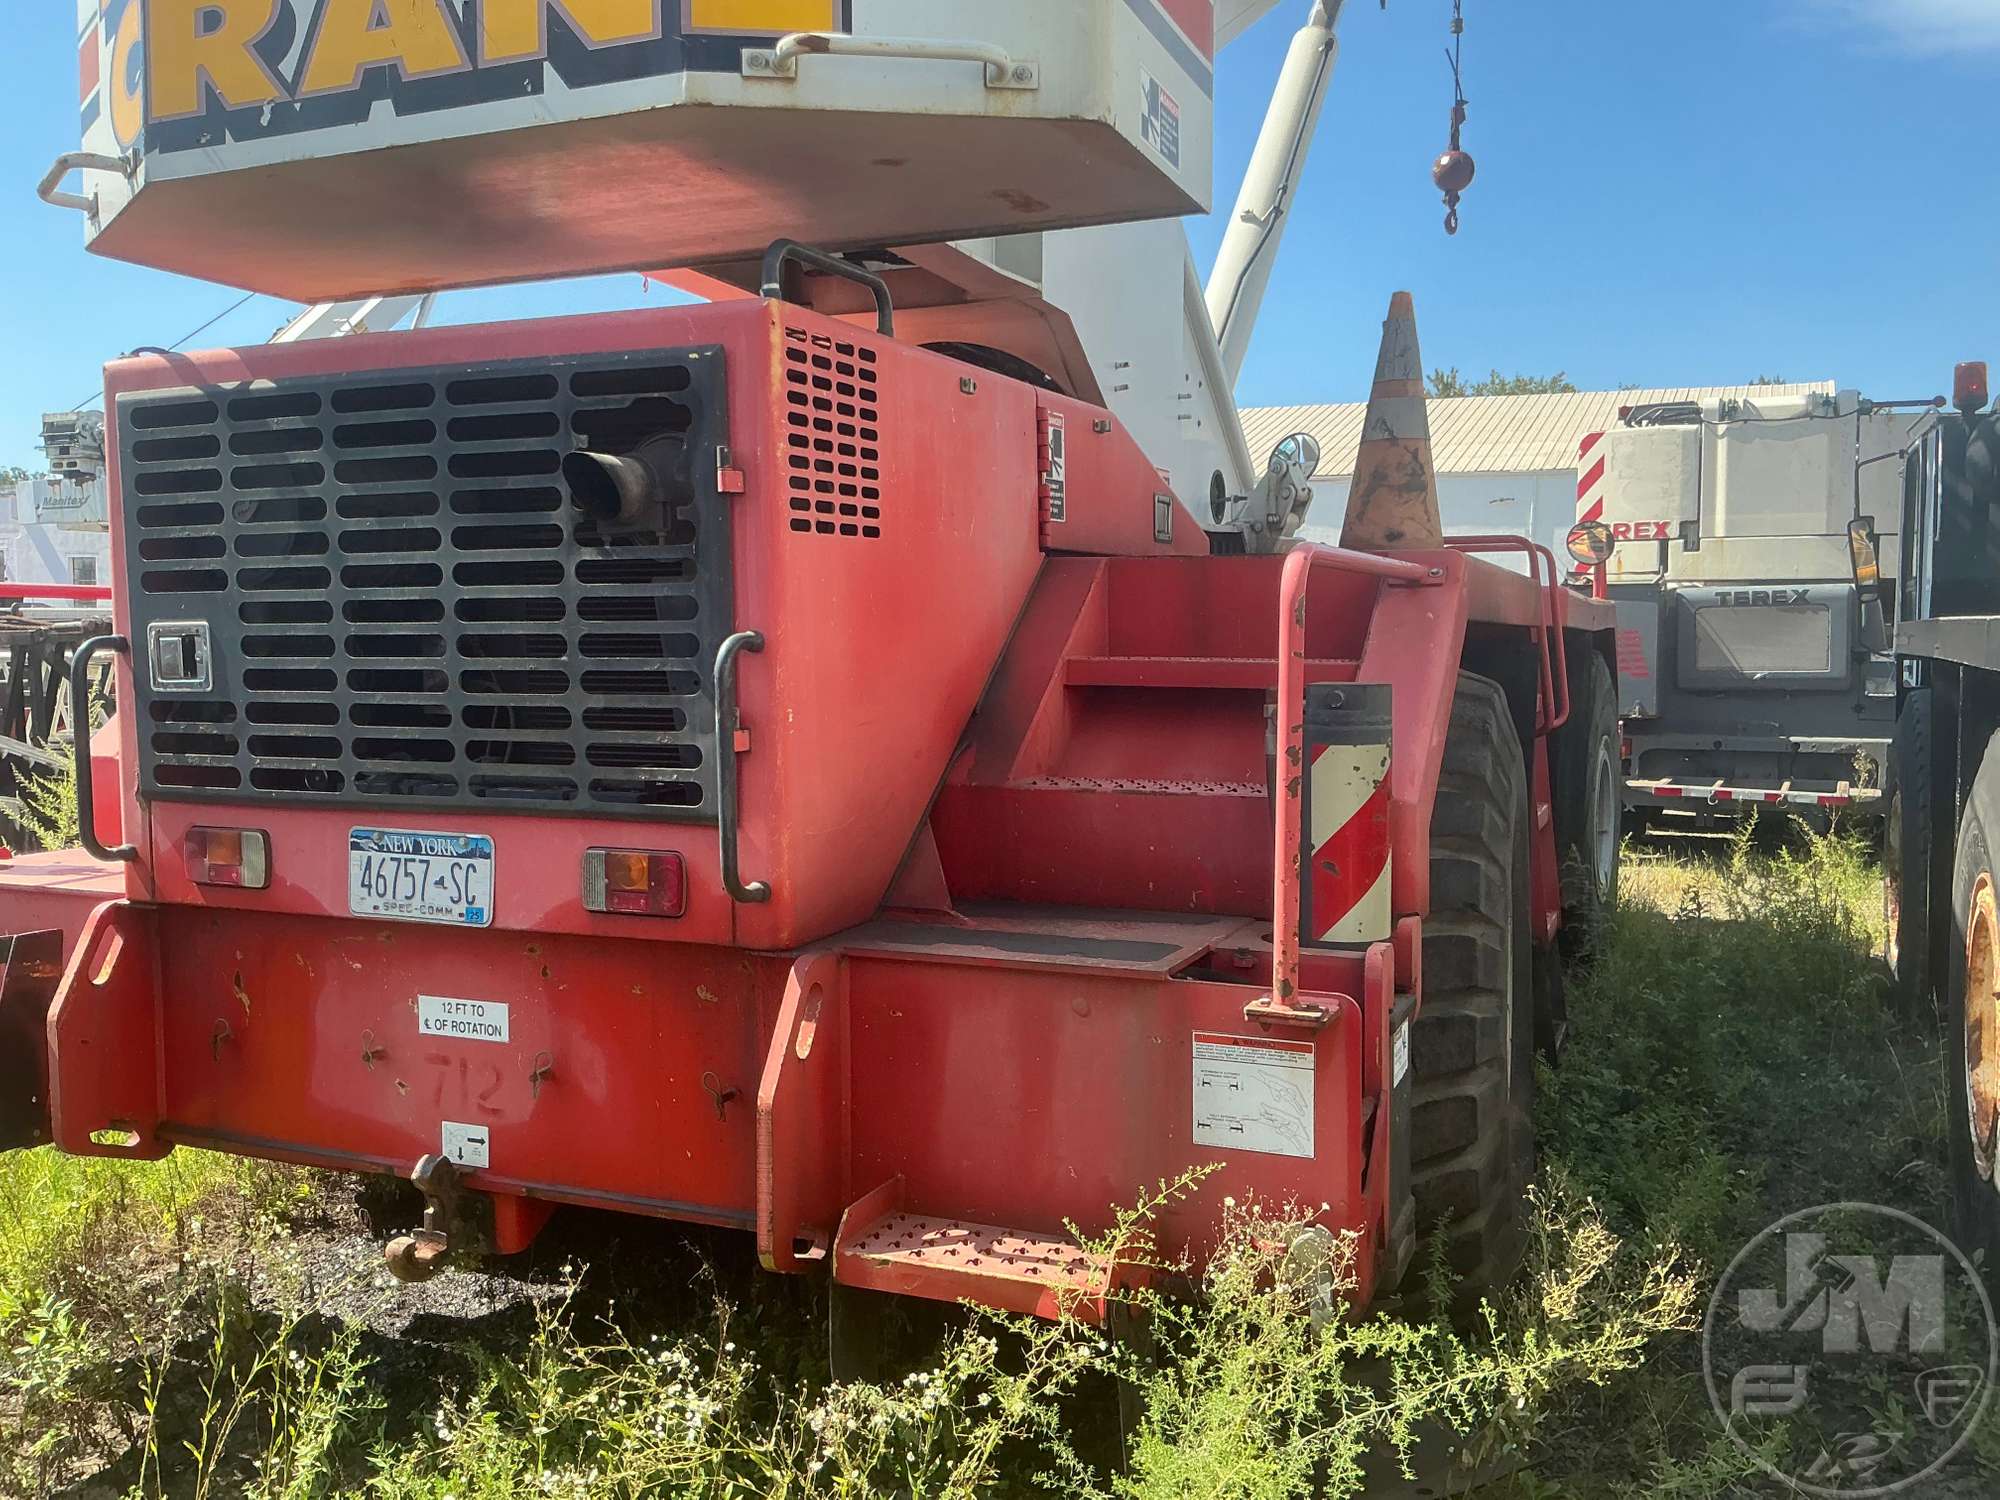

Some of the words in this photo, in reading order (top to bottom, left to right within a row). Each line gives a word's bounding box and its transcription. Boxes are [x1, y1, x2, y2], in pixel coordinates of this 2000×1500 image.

[1613, 521, 1671, 539] REX
[1714, 589, 1810, 606] TEREX
[384, 835, 414, 854] NEW
[420, 838, 458, 856] YORK
[361, 855, 430, 901] 46757
[450, 862, 477, 905] SC
[383, 902, 453, 915] SPEC-COMM
[470, 911, 480, 920] 25
[442, 1002, 452, 1014] 12
[456, 1003, 467, 1016] FT
[471, 1005, 485, 1018] TO
[435, 1019, 448, 1031] OF
[451, 1021, 502, 1037] ROTATION
